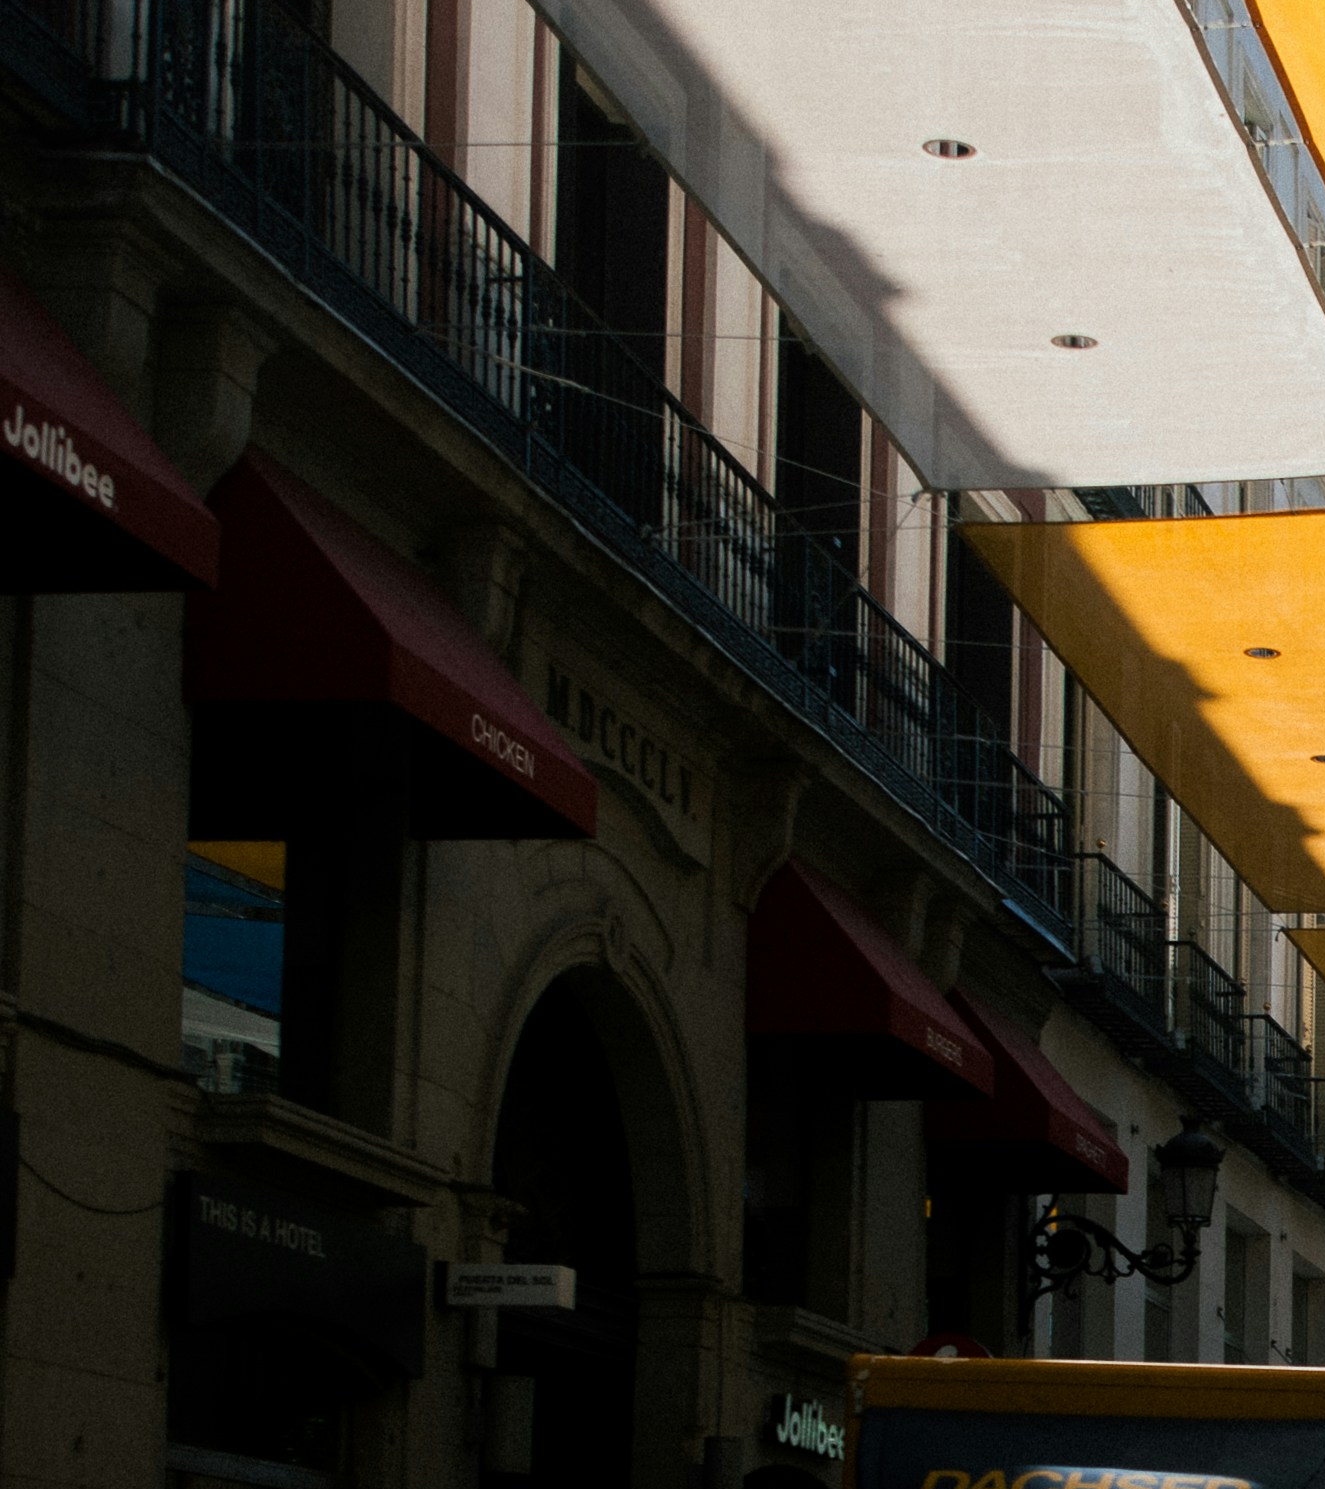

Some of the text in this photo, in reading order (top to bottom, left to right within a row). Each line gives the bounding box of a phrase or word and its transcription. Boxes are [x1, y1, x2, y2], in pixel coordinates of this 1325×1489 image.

[3, 405, 116, 510] Jollibee
[471, 713, 536, 780] CHICKEN
[199, 1194, 327, 1259] THIS IS A HOTEL
